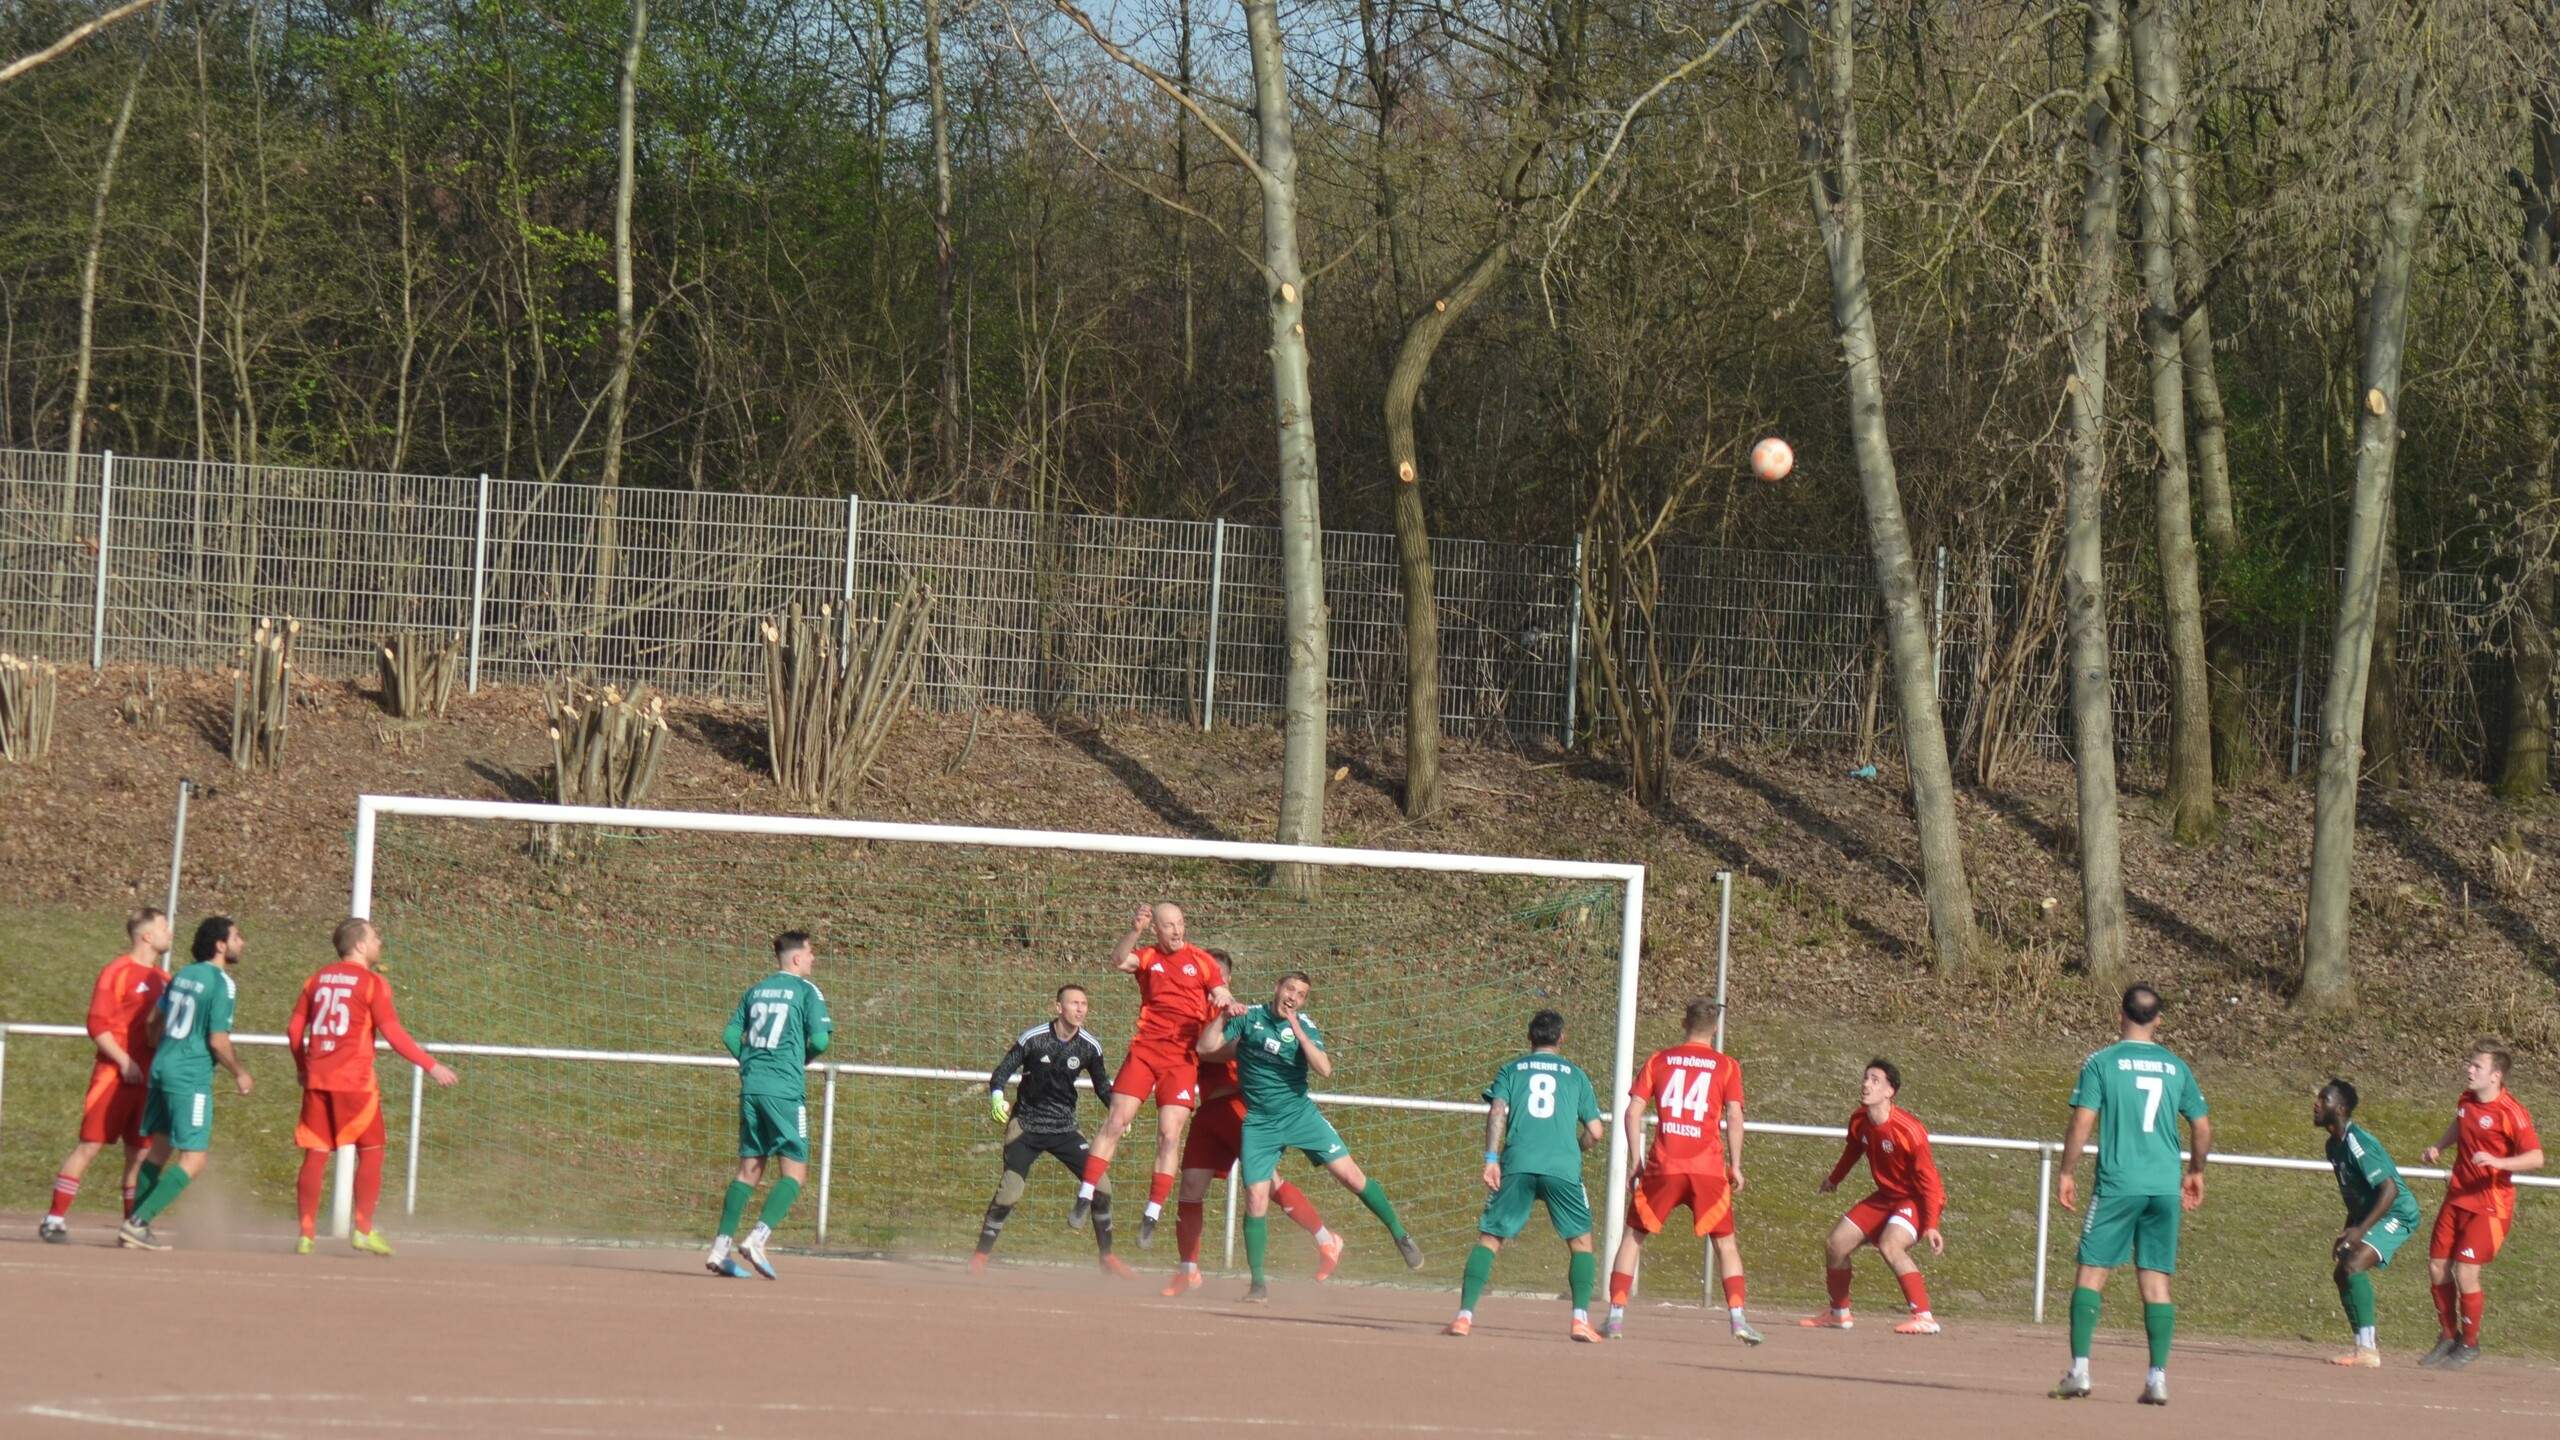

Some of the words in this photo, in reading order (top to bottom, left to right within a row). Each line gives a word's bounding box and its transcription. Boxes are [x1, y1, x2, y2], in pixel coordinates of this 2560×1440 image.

[312, 986, 352, 1036] 25
[749, 1002, 789, 1049] 27
[1530, 1061, 1558, 1071] HERNE
[1559, 1064, 1572, 1075] 70
[2118, 1059, 2132, 1070] SG
[2133, 1059, 2163, 1072] HERNE
[2165, 1062, 2175, 1075] 70
[1527, 1073, 1556, 1119] 8
[1661, 1068, 1712, 1121] 44
[2135, 1075, 2163, 1133] 7
